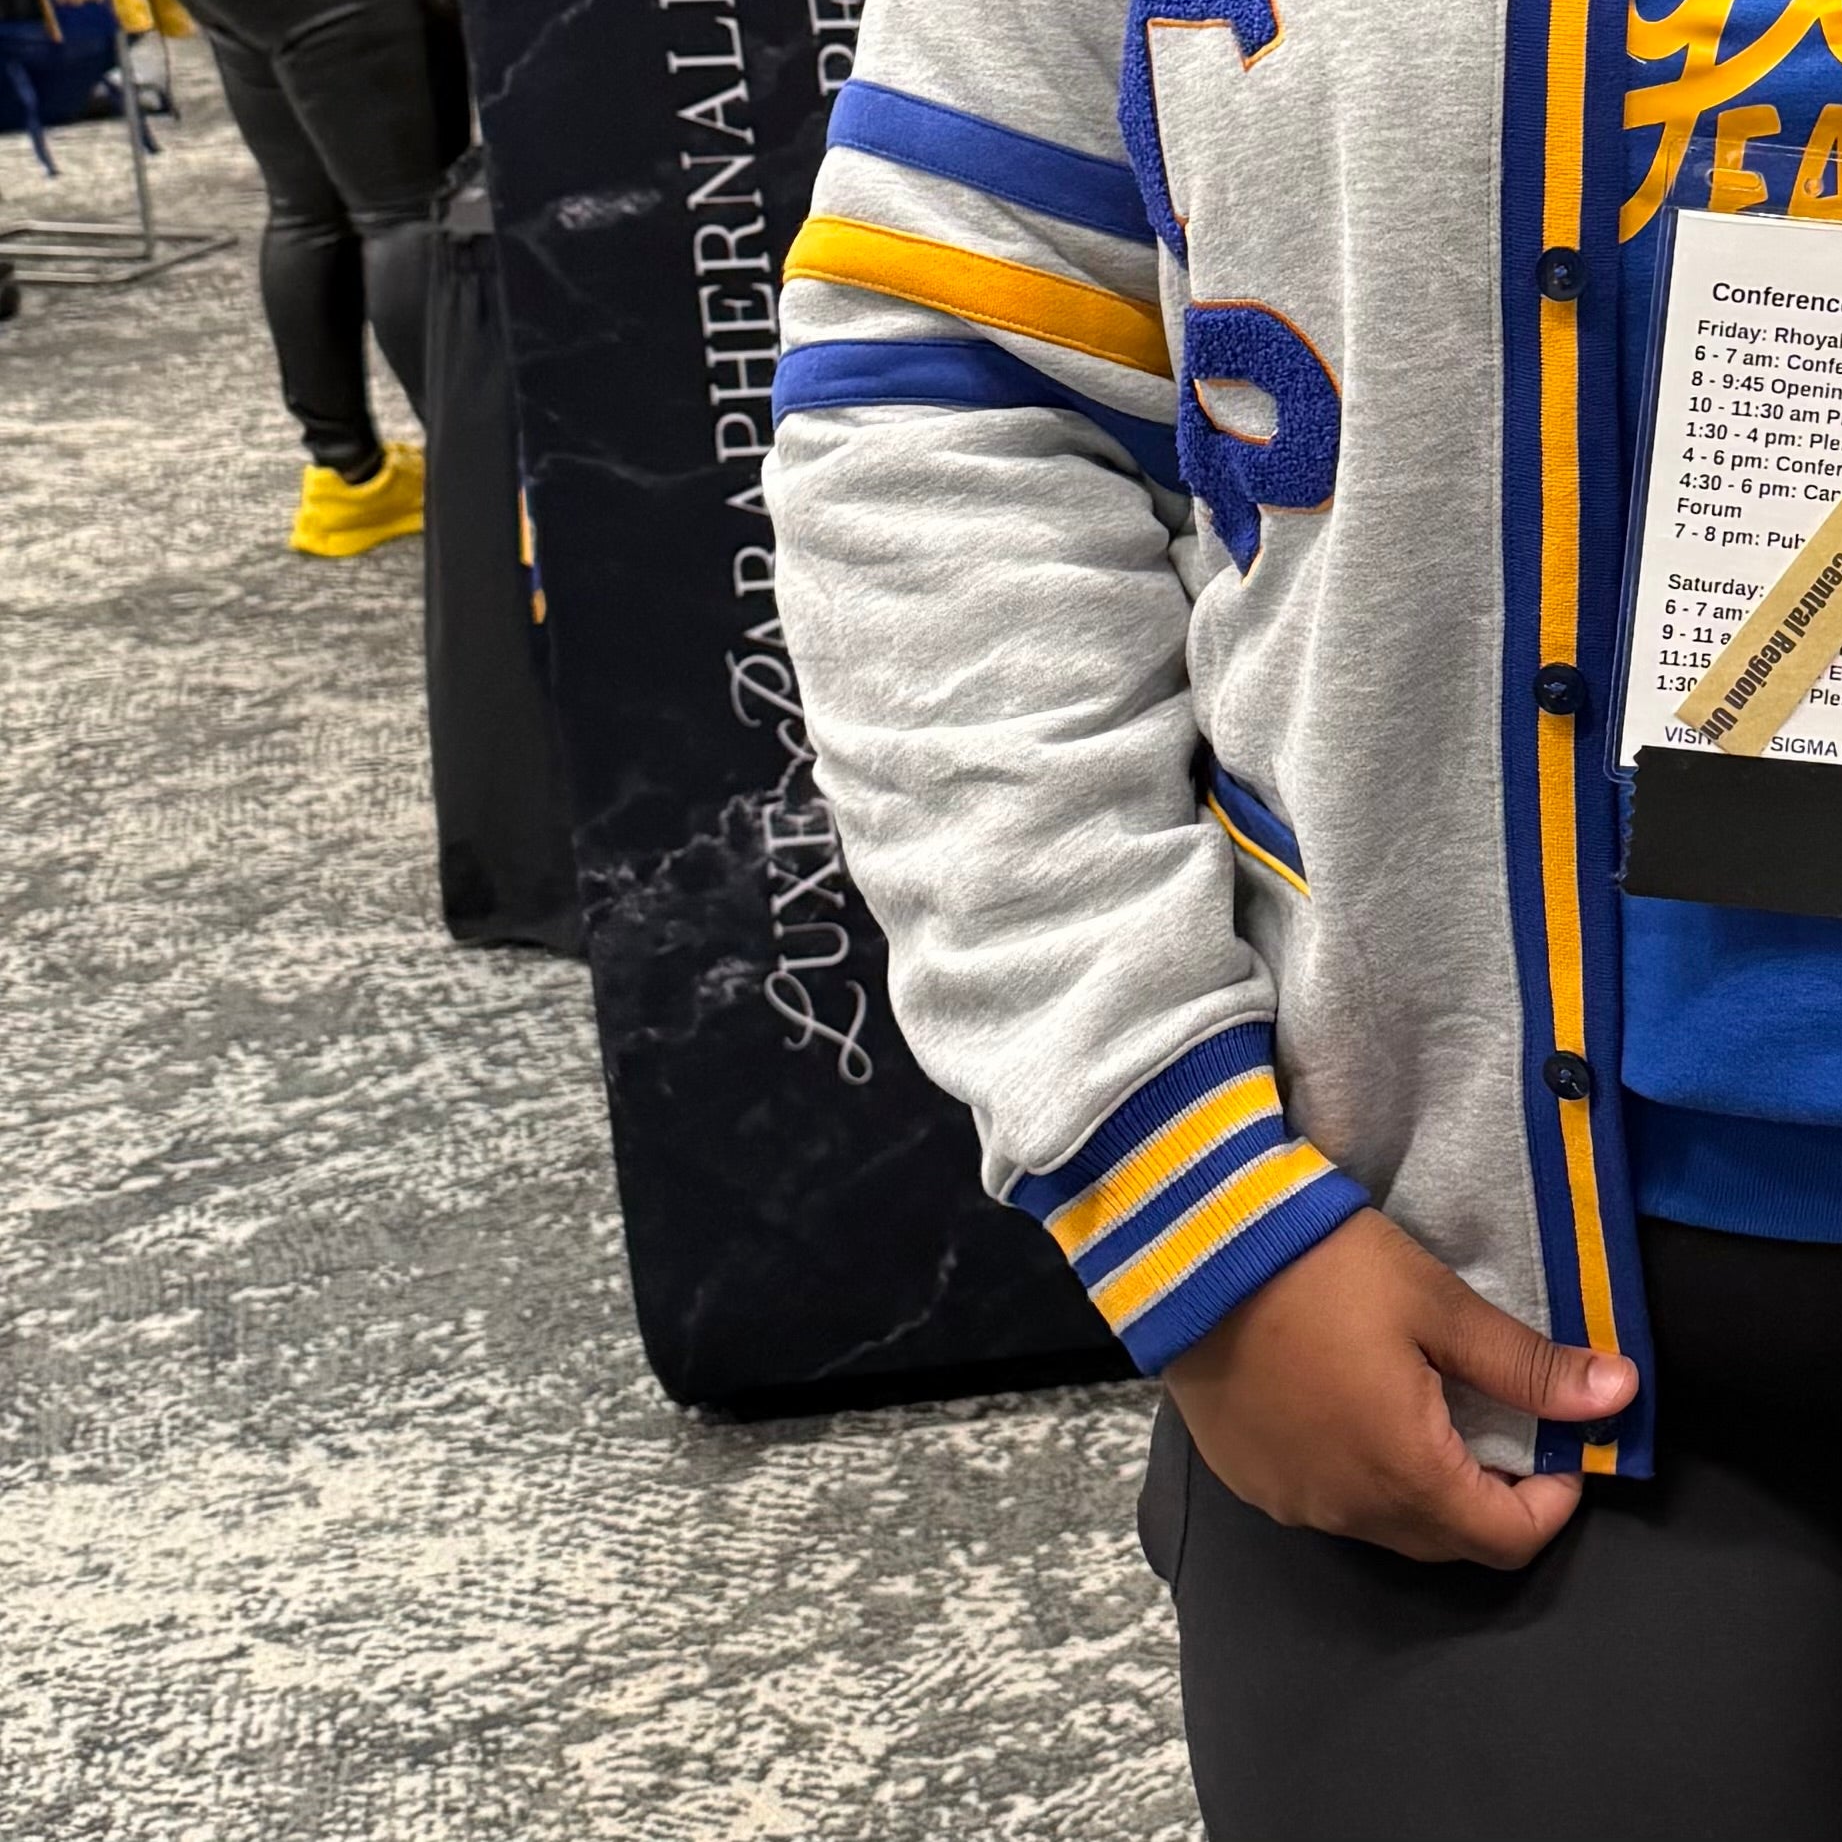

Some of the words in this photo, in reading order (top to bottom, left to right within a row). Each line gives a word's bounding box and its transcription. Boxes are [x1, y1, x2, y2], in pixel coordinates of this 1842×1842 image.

[1697, 319, 1767, 344] Friday:
[1694, 345, 1706, 361] 6
[1725, 348, 1738, 364] 7
[1742, 352, 1780, 369] am:
[1692, 371, 1703, 387] 8
[1722, 373, 1765, 393] 9:45
[1688, 396, 1712, 413] 10
[1731, 401, 1784, 420] 11:30
[1790, 408, 1820, 424] am
[1686, 421, 1728, 441] 1:30
[1746, 427, 1758, 444] 4
[1764, 431, 1804, 451] pm:
[1682, 446, 1694, 463] 4
[1713, 449, 1725, 466] 6
[1731, 454, 1769, 473] pm:
[1679, 472, 1722, 491] 4:30
[1740, 478, 1752, 494] 6
[1758, 481, 1797, 500] pm:
[1677, 497, 1743, 518] Forum
[1674, 523, 1685, 538] 7
[1704, 526, 1716, 542] 8
[1722, 531, 1760, 549] pm:
[1668, 573, 1764, 599] Saturday:
[1665, 599, 1677, 615] 6
[1696, 602, 1708, 617] 7
[1662, 624, 1674, 640] 9
[1693, 627, 1713, 644] 11
[1659, 649, 1712, 669] 11:15
[1723, 629, 1797, 711] Region
[1656, 675, 1697, 693] 1:30
[1770, 736, 1839, 758] SIGMA
[763, 796, 873, 1085] LUXE
